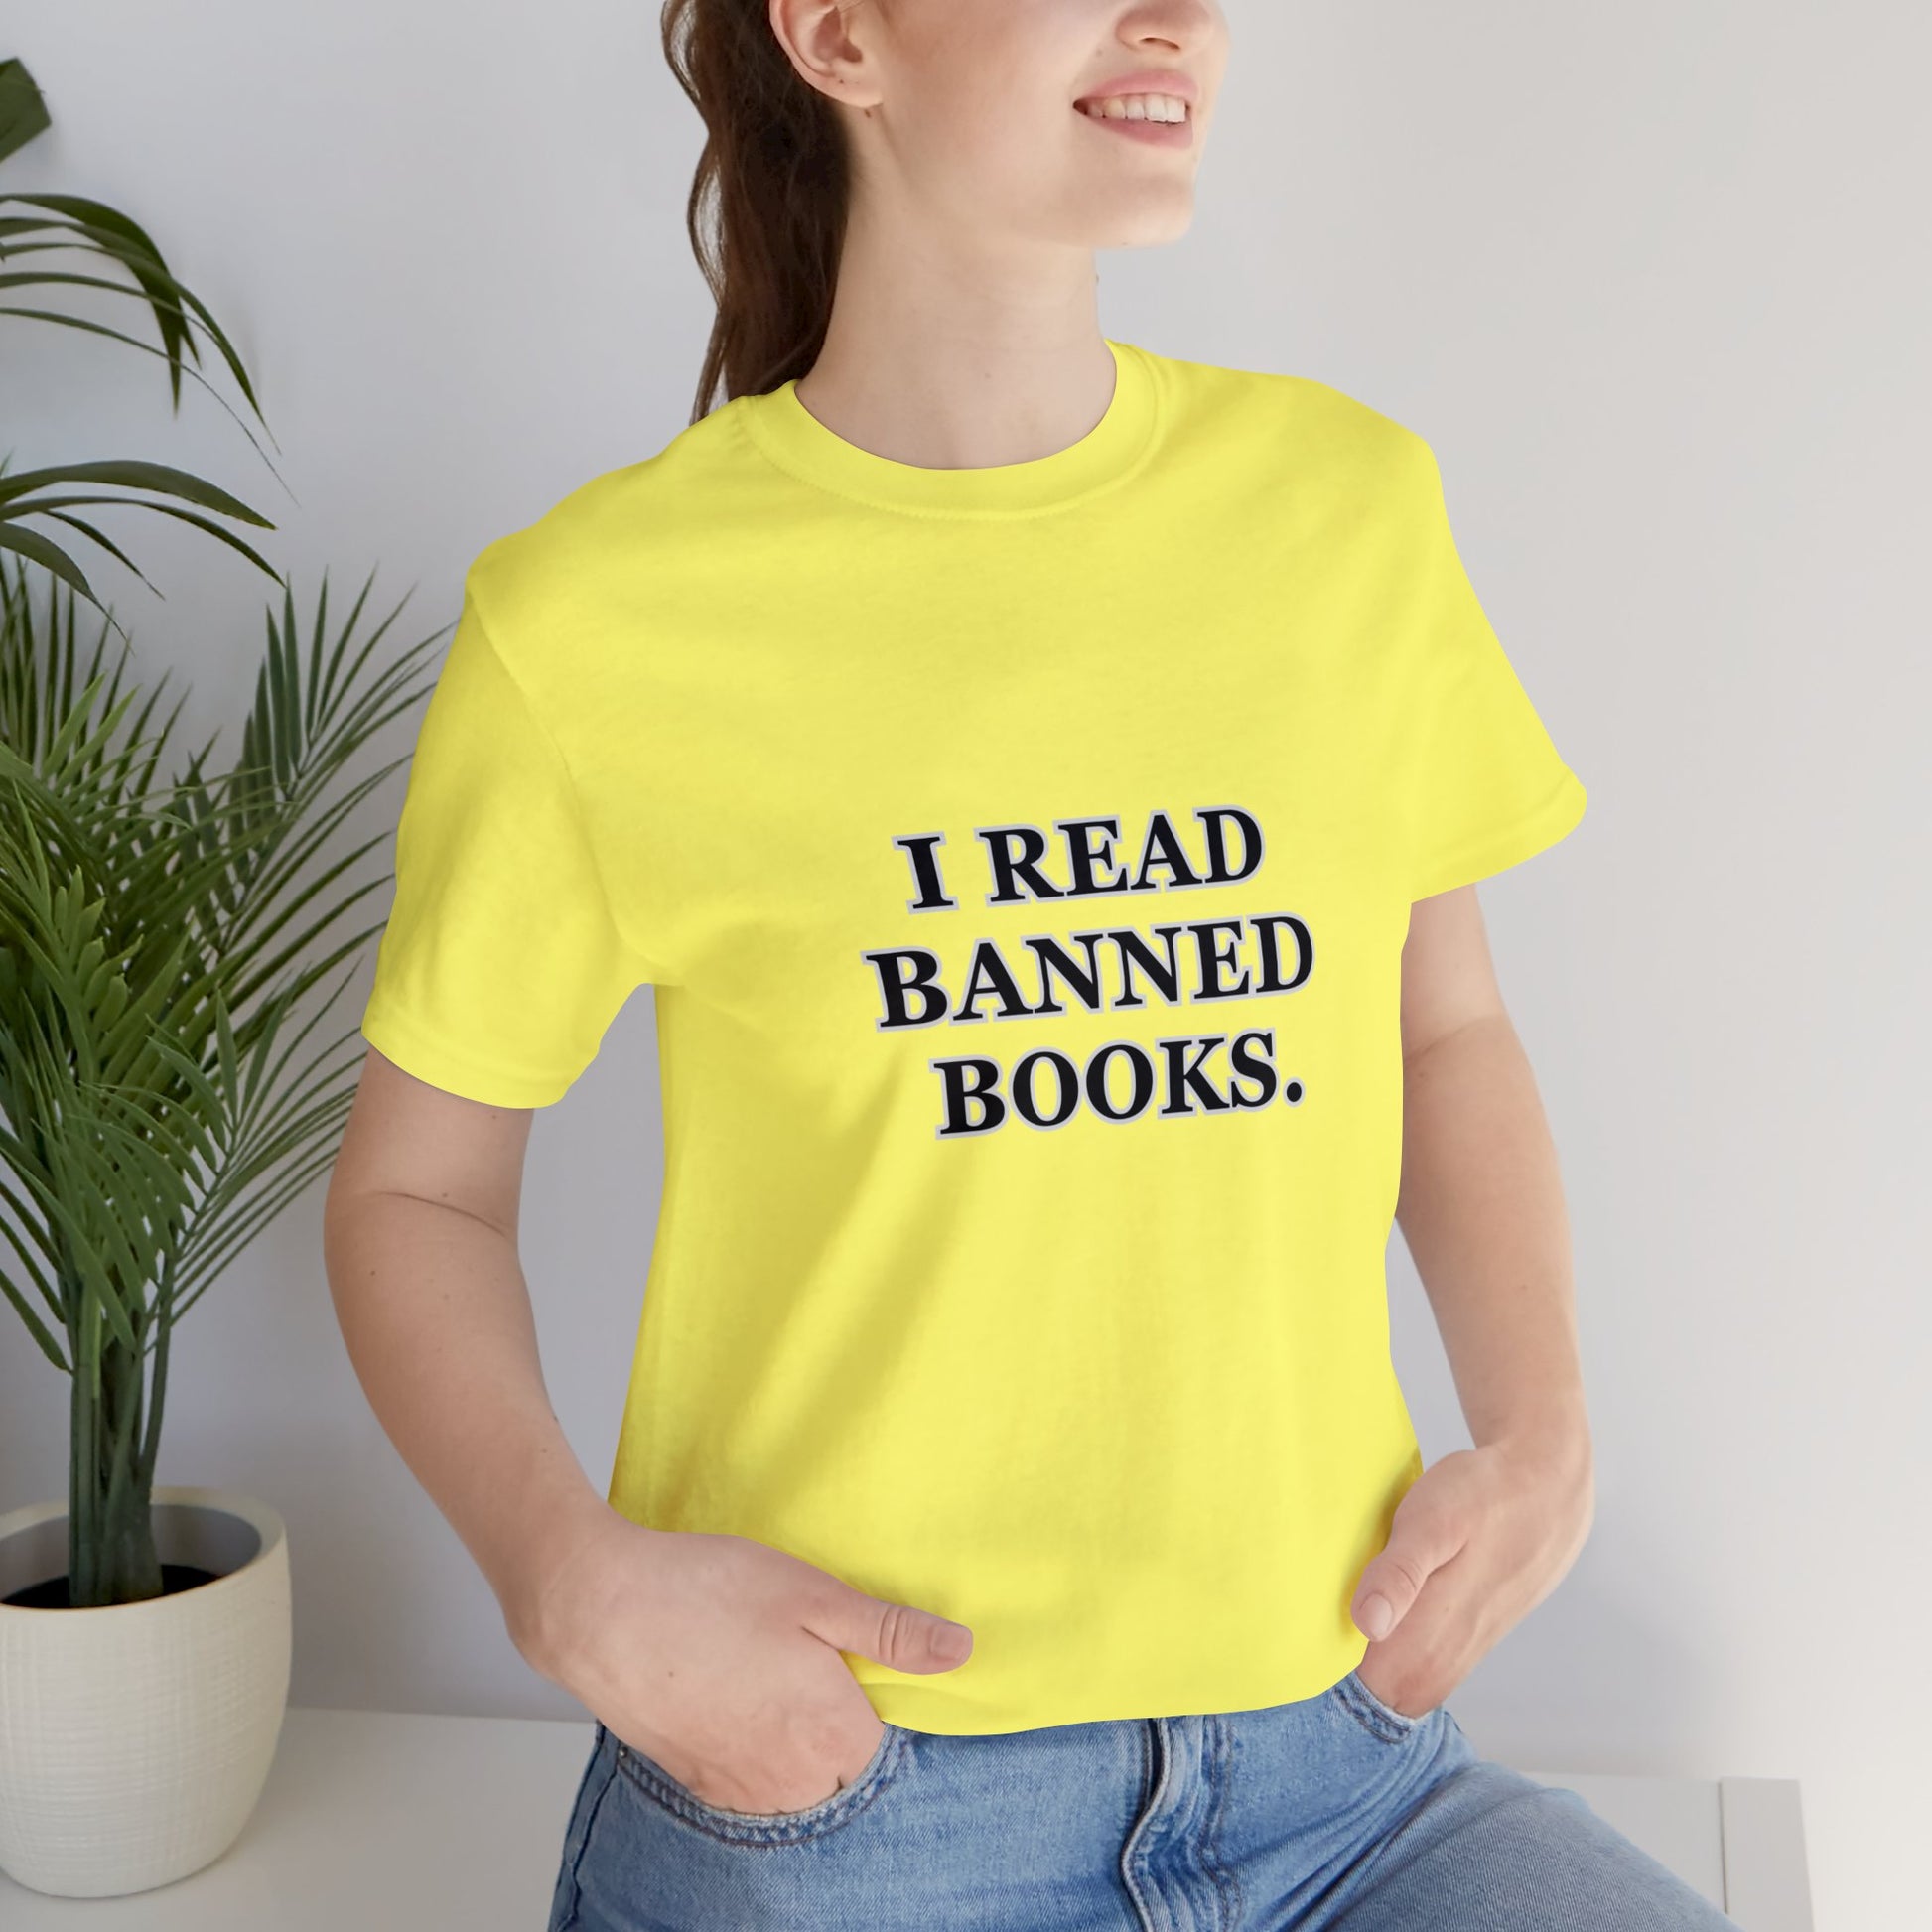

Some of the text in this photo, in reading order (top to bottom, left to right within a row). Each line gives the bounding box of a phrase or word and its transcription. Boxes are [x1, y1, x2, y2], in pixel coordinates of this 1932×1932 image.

[893, 805, 1264, 913] I READ
[861, 912, 1315, 1032] BANNED
[930, 1028, 1305, 1139] BOOKS.
